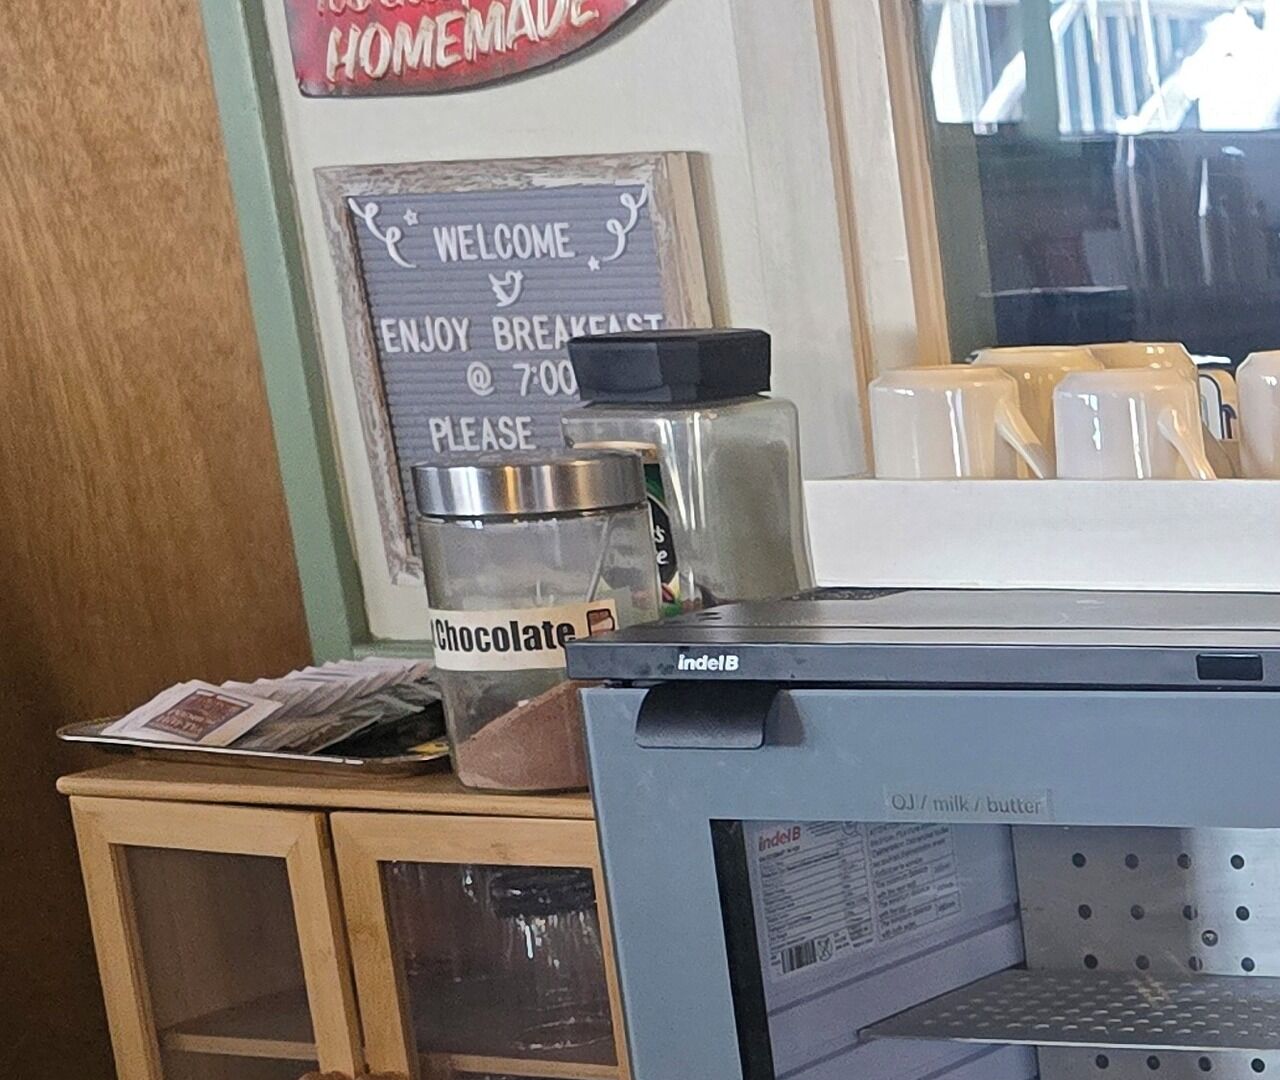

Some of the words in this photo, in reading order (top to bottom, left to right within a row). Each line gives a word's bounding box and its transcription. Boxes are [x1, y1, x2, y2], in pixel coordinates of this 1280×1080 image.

[433, 221, 575, 263] WELCOME
[381, 317, 471, 354] ENJOY
[467, 361, 493, 397] @
[429, 415, 533, 452] PLEASE
[435, 619, 576, 653] Chocolate
[933, 795, 970, 813] milk
[986, 796, 1042, 815] butter
